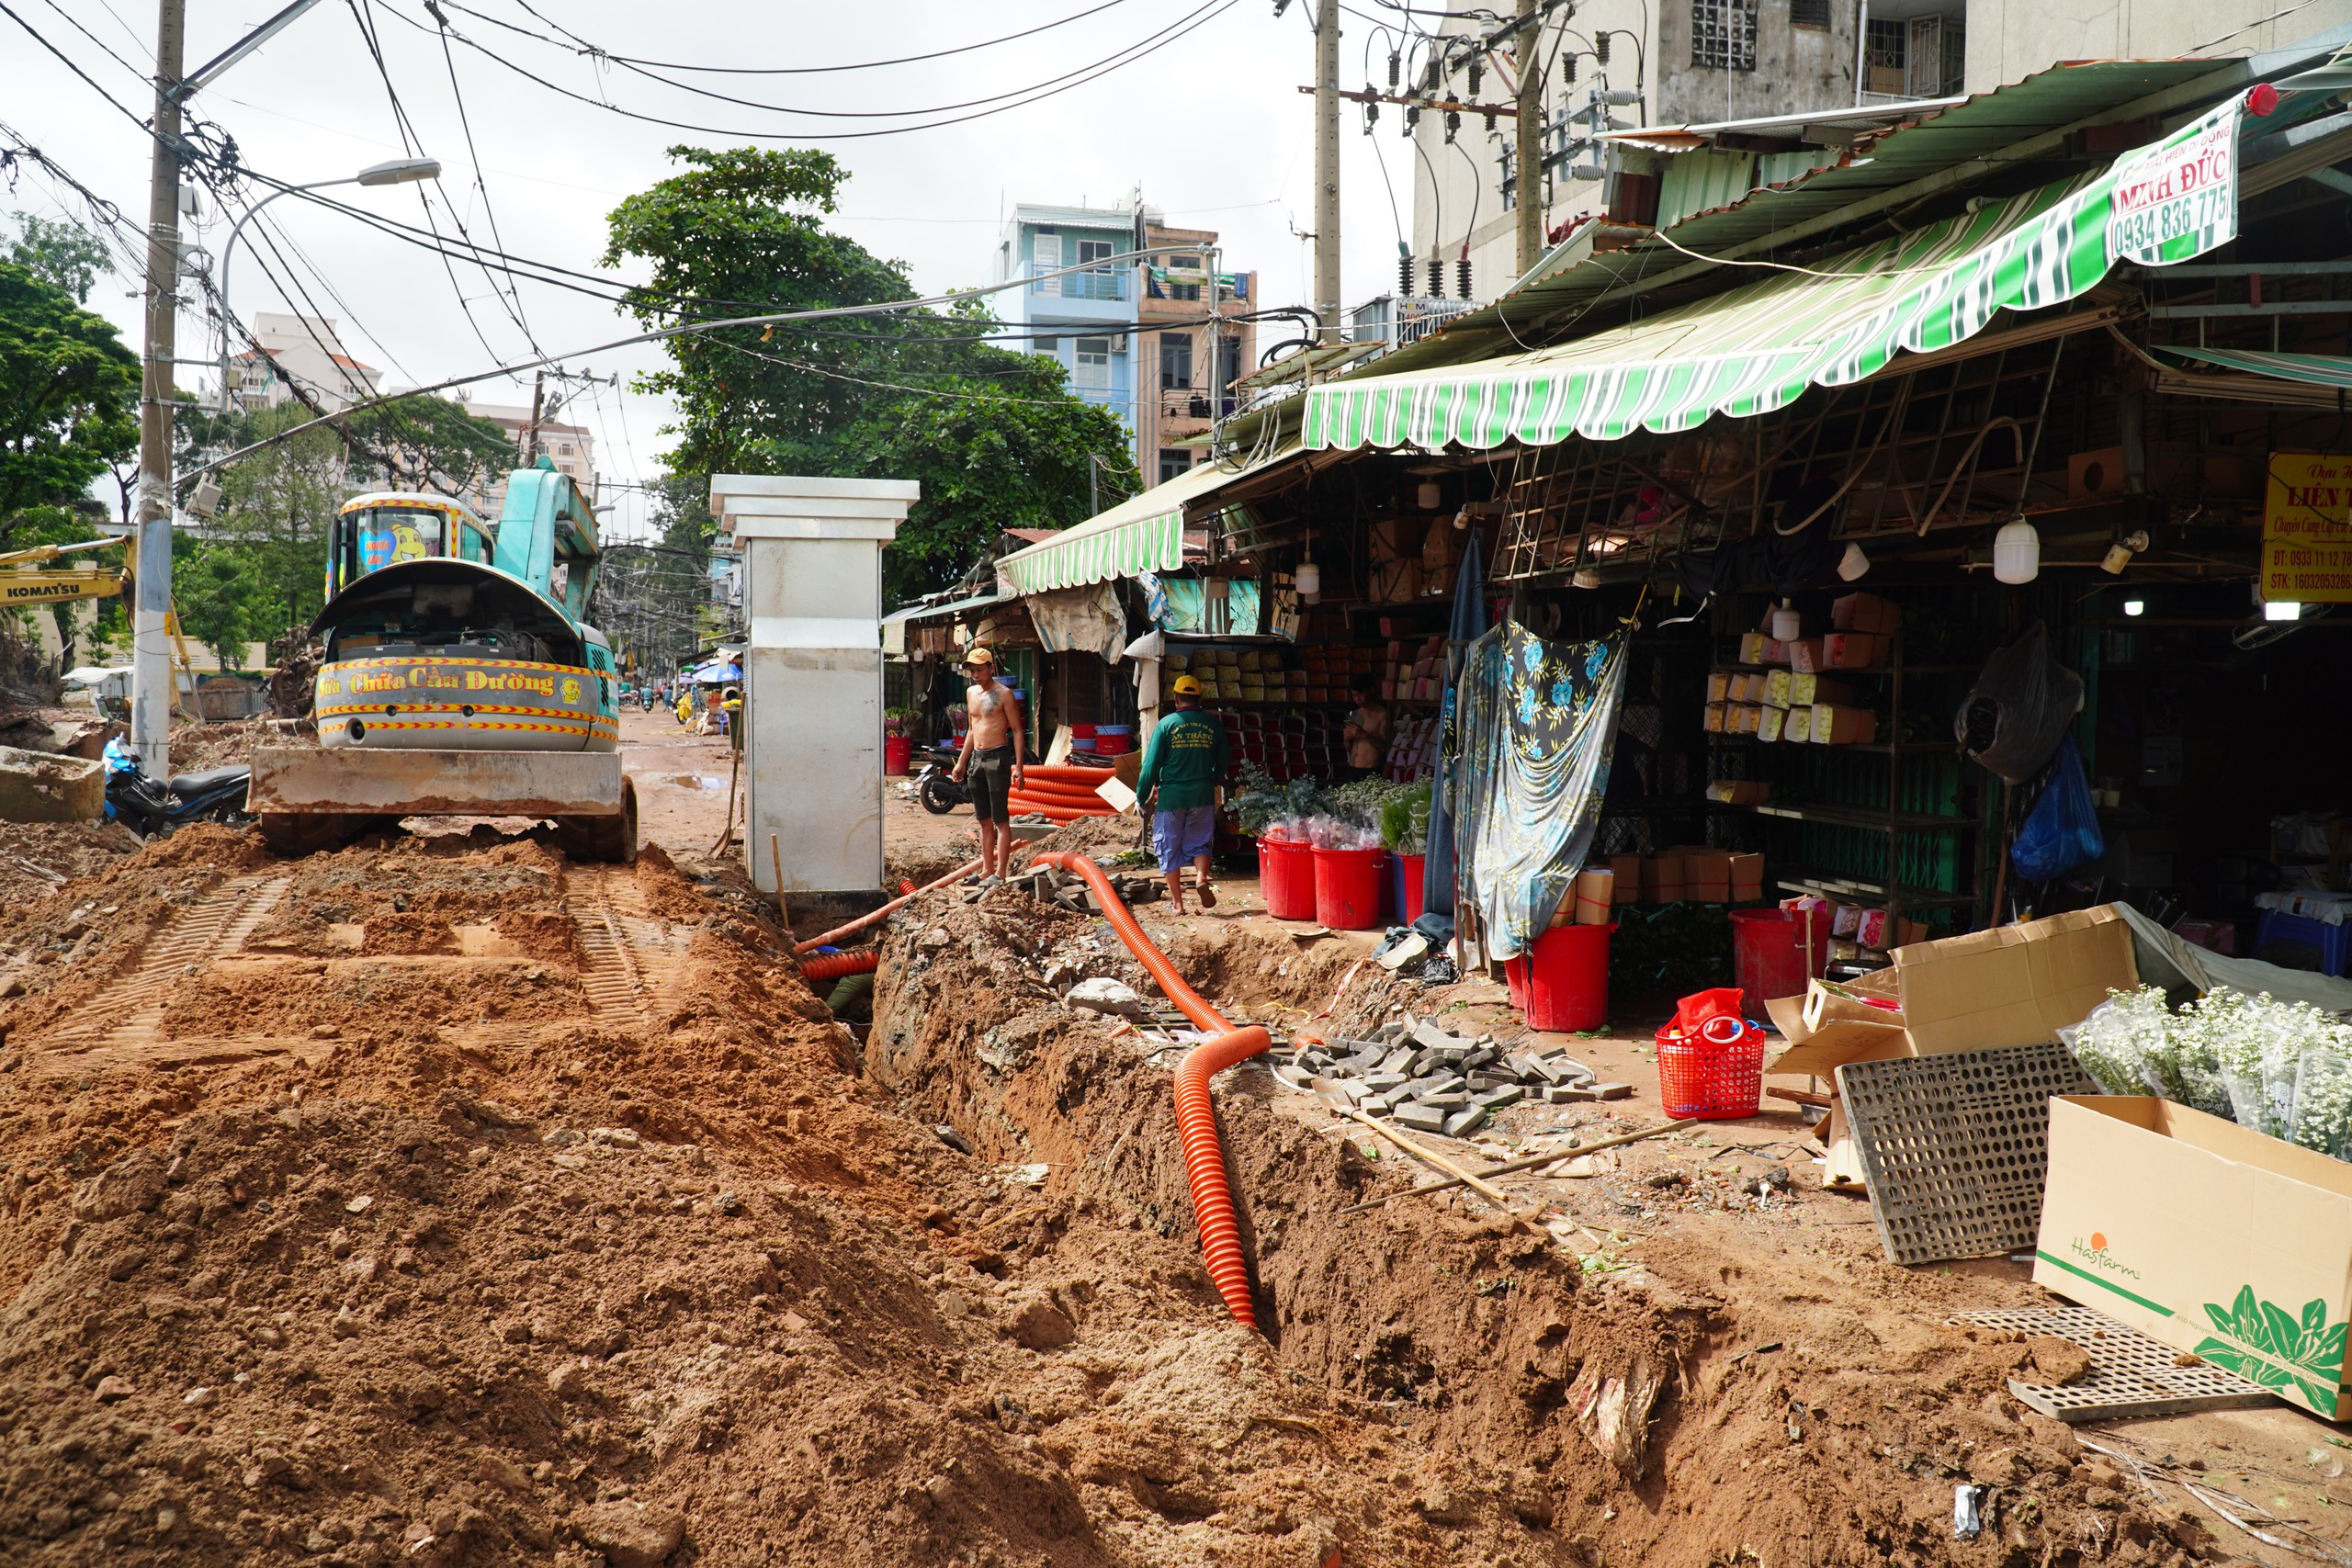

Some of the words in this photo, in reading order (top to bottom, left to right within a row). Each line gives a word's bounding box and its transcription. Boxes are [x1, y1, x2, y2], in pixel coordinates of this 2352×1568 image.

[2188, 139, 2199, 152] DI
[2119, 170, 2173, 214] MINH
[2180, 148, 2227, 191] ĐỨC
[2114, 209, 2155, 255] 0934
[2161, 197, 2192, 241] 836
[2198, 186, 2228, 228] 775
[2286, 482, 2341, 508] LIÊN
[2273, 550, 2288, 566] ĐT:
[2290, 550, 2312, 566] 0933
[2315, 551, 2324, 566] 11
[2328, 551, 2338, 567] 12
[7, 583, 80, 597] KOMATSU
[2270, 573, 2290, 589] STK:
[2294, 573, 2352, 590] 16032053286
[349, 671, 408, 694] Chữa
[409, 667, 459, 690] Cầu
[464, 670, 555, 697] Đường
[2072, 1236, 2140, 1280] Hasfarm
[2176, 1314, 2188, 1324] 450
